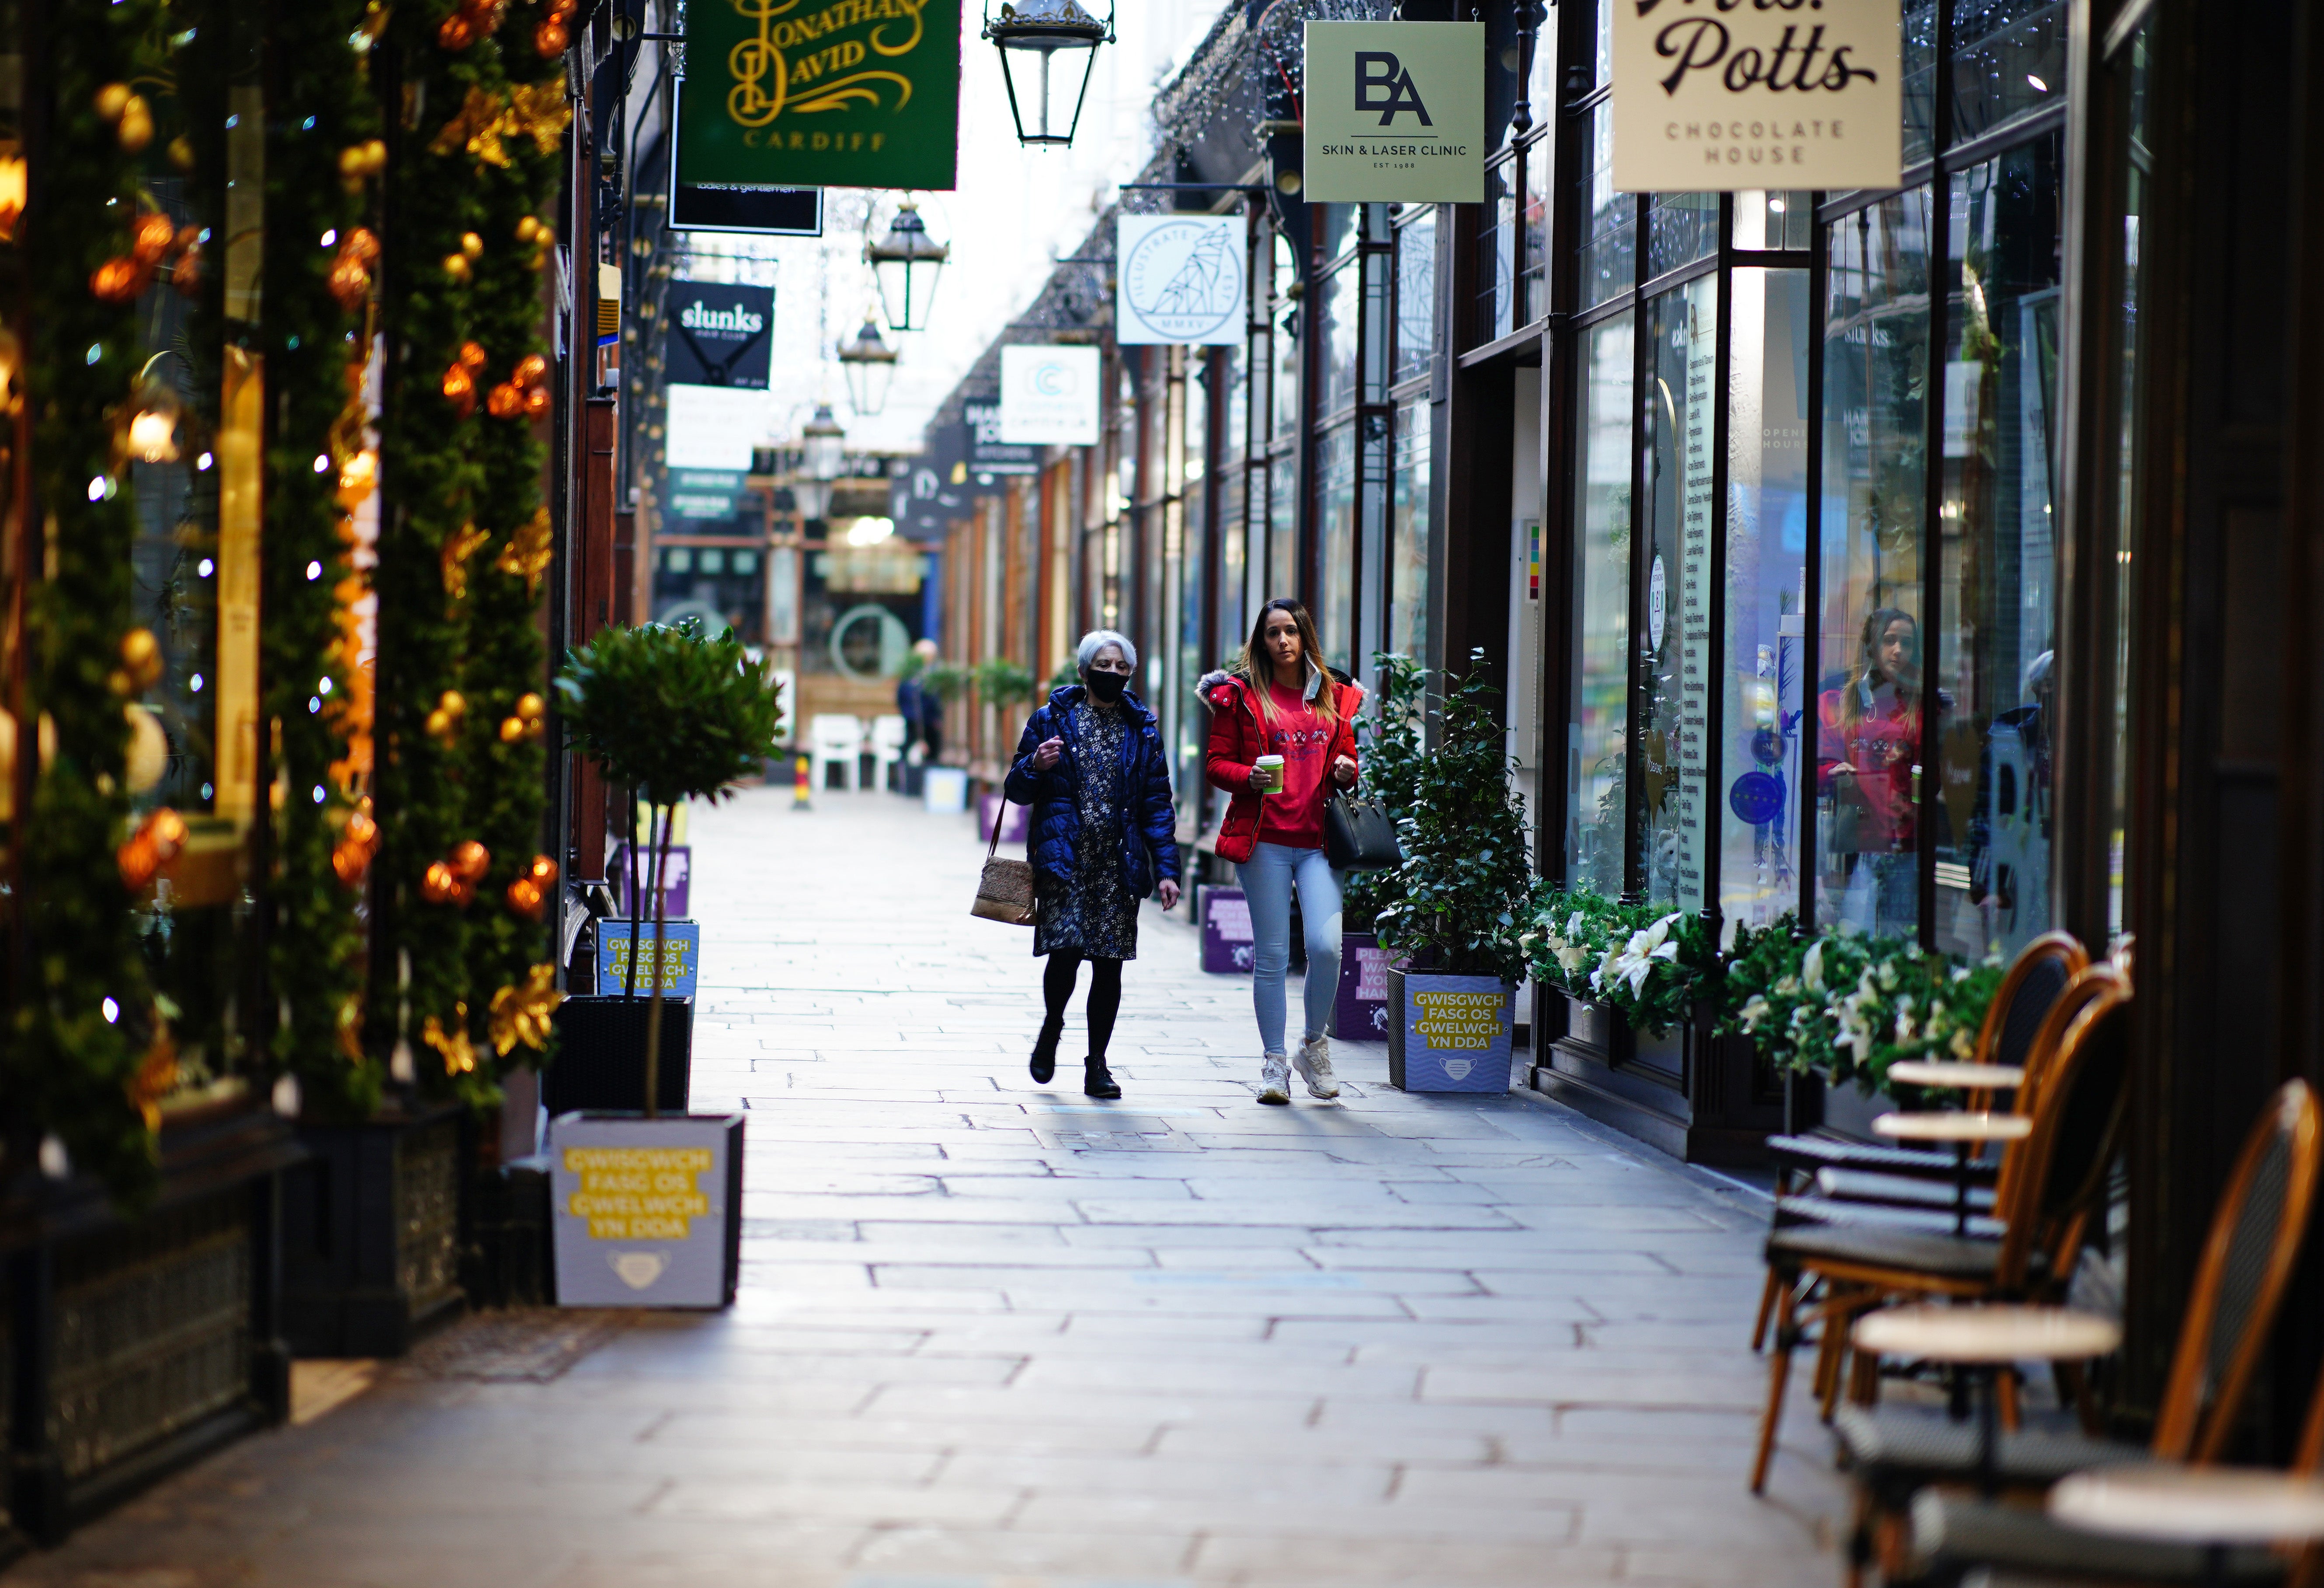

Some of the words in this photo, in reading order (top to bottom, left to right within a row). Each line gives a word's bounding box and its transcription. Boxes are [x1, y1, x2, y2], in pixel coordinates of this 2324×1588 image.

[1655, 17, 1877, 98] Potts
[1355, 52, 1433, 126] BA
[1665, 120, 1845, 141] CHOCOLATE
[743, 130, 887, 153] CARDIFF
[1322, 146, 1353, 155] SKIN
[1359, 146, 1368, 155] &
[1372, 146, 1416, 156] LASER
[1421, 146, 1467, 156] CLINIC
[1705, 146, 1805, 164] HOUSE
[740, 183, 796, 193] gentlemen
[681, 300, 763, 333] slunks
[1763, 428, 1806, 437] OPENI
[621, 951, 655, 963] FSG
[1363, 962, 1388, 973] WA
[1416, 994, 1504, 1006] GWISGWCH
[1429, 1008, 1467, 1020] FASG
[1470, 1008, 1491, 1020] OS
[1419, 1022, 1500, 1034] GWELWCH
[1430, 1036, 1452, 1047] YN
[1455, 1036, 1488, 1048] DDA
